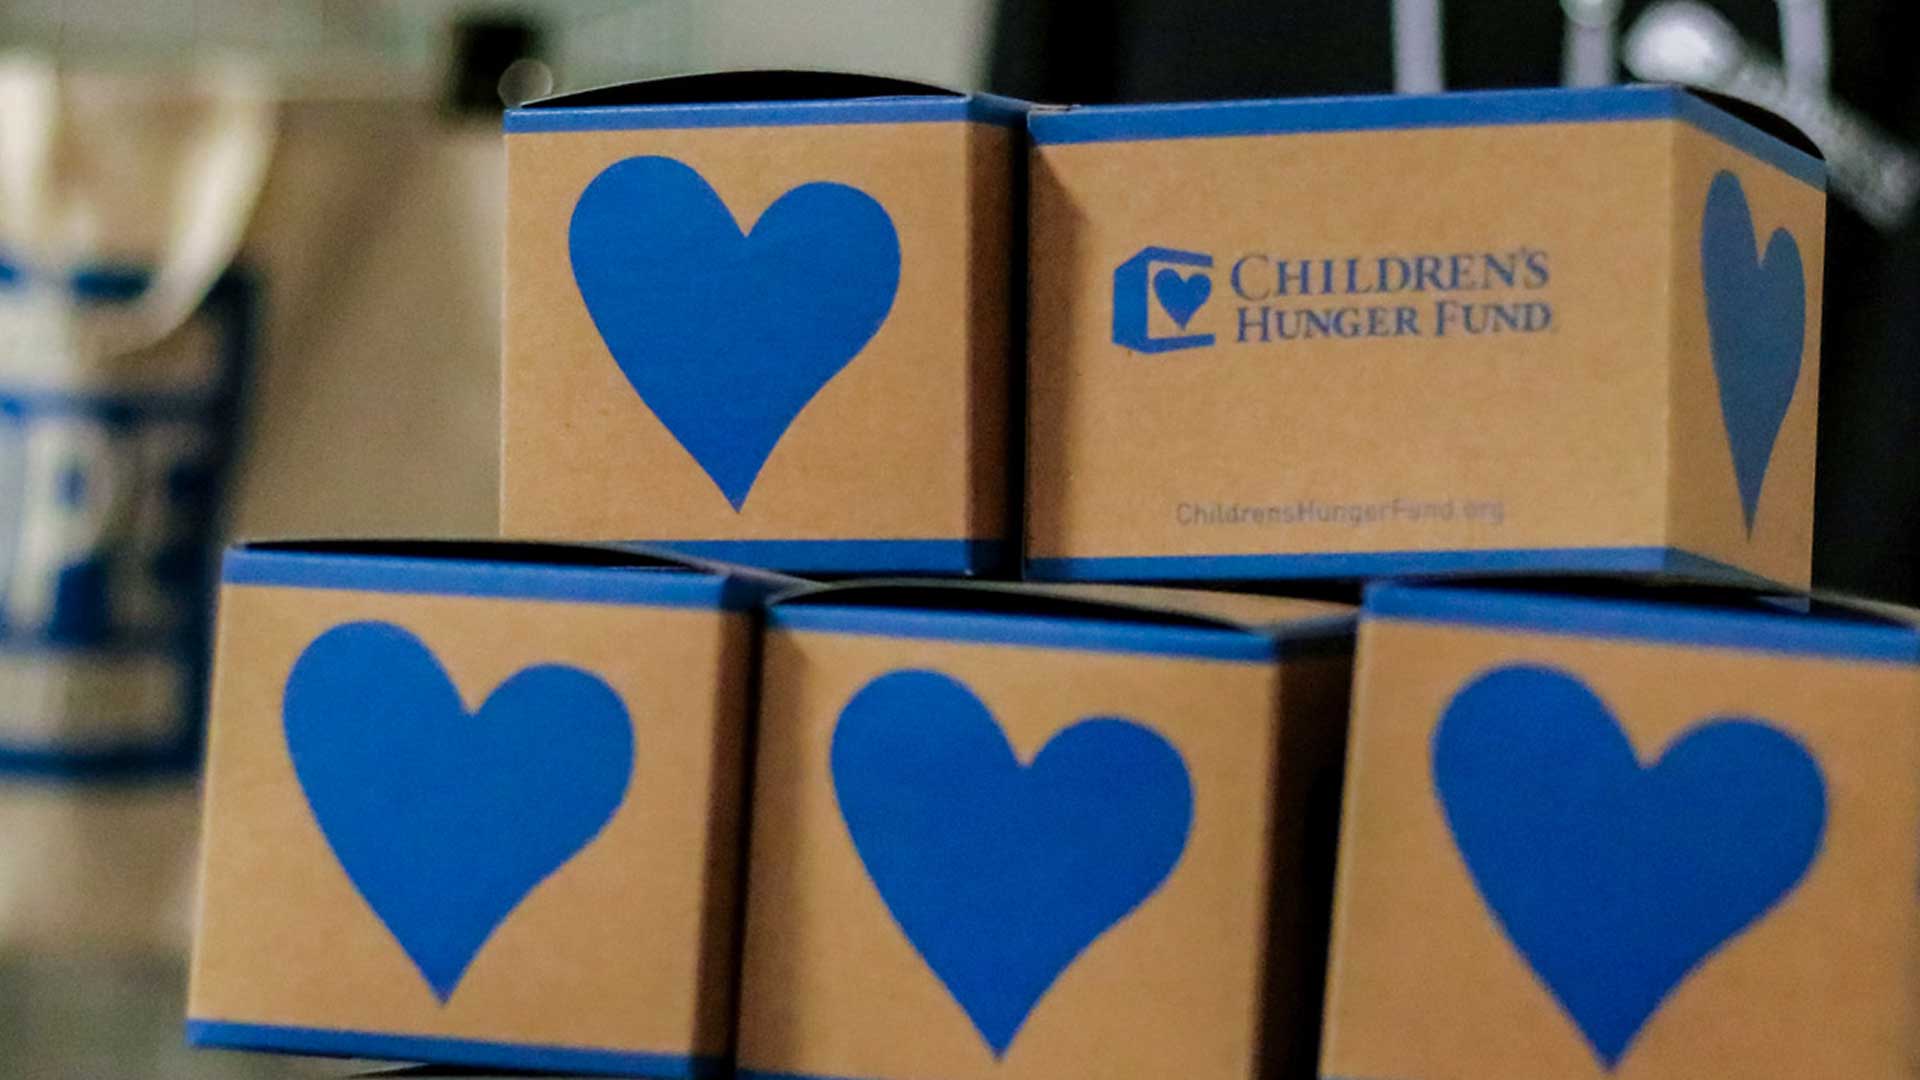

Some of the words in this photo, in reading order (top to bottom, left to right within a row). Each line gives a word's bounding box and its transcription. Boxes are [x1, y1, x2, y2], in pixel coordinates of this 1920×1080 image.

[1230, 247, 1550, 302] CHILDREN'S
[1235, 305, 1421, 343] HUNGER
[1175, 499, 1505, 527] ChildrensHungerFund.org
